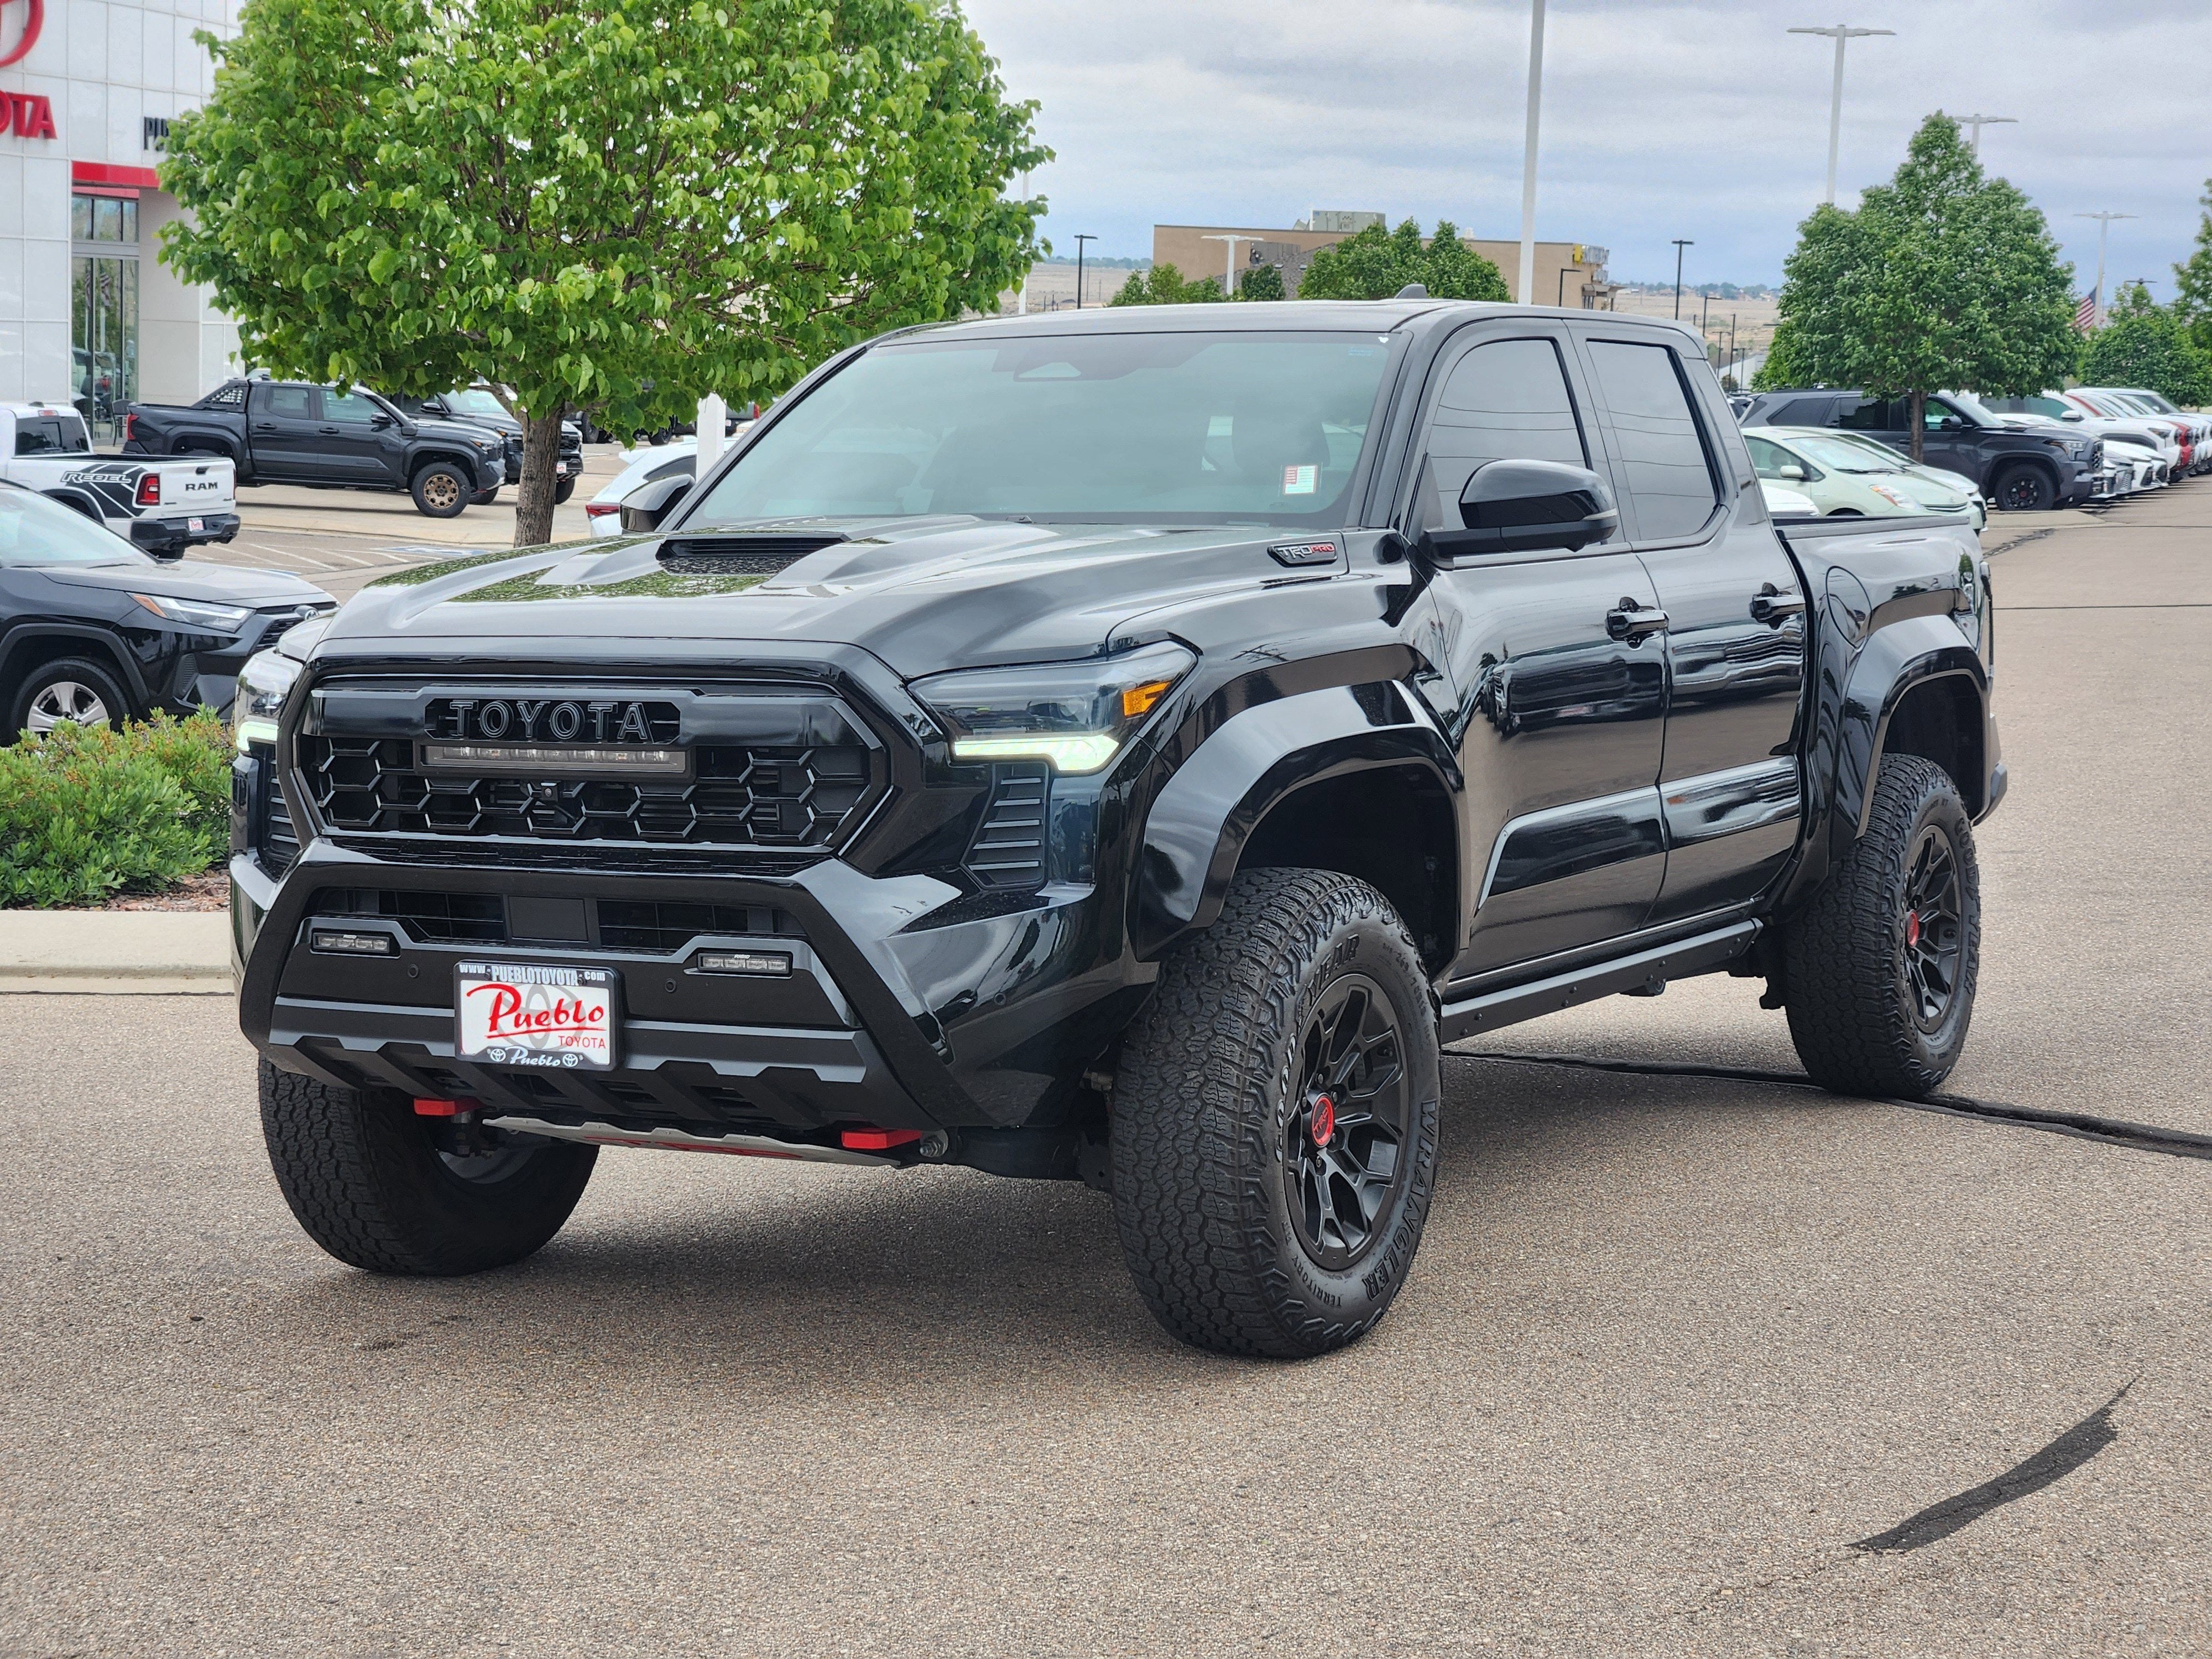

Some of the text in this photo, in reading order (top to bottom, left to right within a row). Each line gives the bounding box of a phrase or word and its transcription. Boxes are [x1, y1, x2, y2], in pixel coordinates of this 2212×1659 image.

[60, 471, 132, 483] REBEL
[185, 481, 218, 491] RAM
[1311, 545, 1335, 554] PRO
[450, 700, 653, 740] TOYOTA
[466, 983, 604, 1032] Pueblo
[558, 1035, 606, 1049] TOYOTA
[505, 1046, 561, 1067] Pueblo
[1361, 1100, 1437, 1301] WRANGLER
